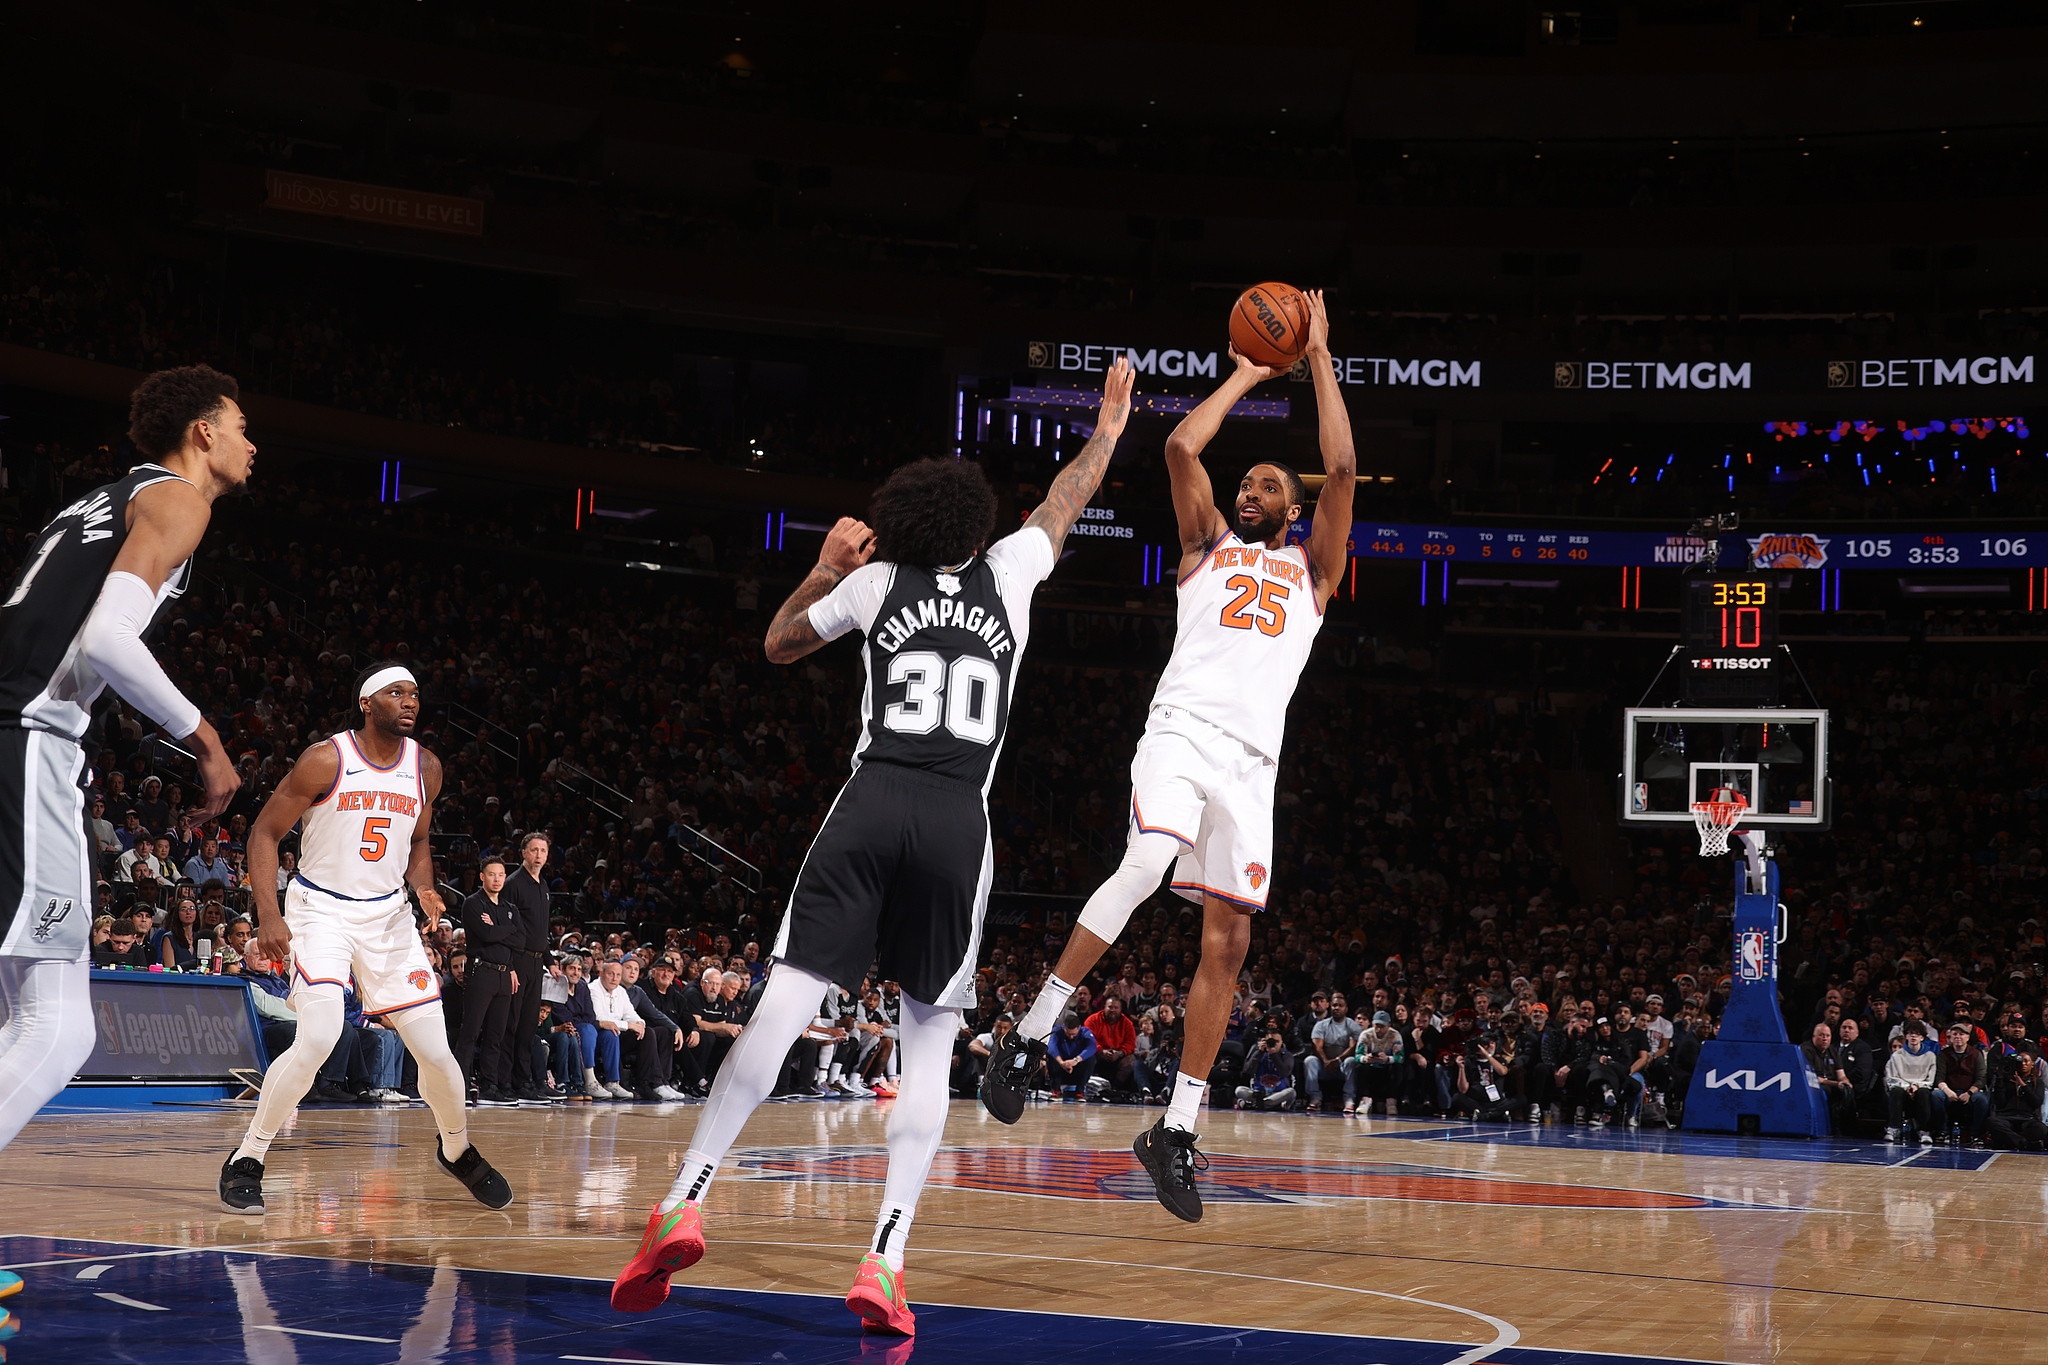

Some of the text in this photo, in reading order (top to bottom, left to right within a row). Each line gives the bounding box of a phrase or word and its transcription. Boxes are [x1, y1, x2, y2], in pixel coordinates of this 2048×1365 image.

[273, 177, 476, 227] Infosys SUITE LEVEL
[1248, 291, 1286, 342] Wilson
[1587, 361, 1751, 389] BETMGM
[1860, 355, 2034, 388] BETMGM
[1069, 523, 1134, 539] ARRIORS
[1377, 528, 1399, 537] FG%
[1427, 530, 1449, 540] FT%
[1479, 533, 1493, 541] TO
[1507, 534, 1526, 543] STL
[1538, 535, 1557, 544] AST
[1569, 535, 1589, 544] REB
[1666, 536, 1683, 546] NEW
[1922, 535, 1944, 545] 4th
[1371, 540, 1405, 554] 44.4
[1422, 543, 1456, 557] 92.9
[1481, 546, 1492, 558] 5
[1512, 547, 1522, 559] 6
[1537, 547, 1557, 560] 26
[1568, 548, 1588, 561] 40
[1654, 546, 1707, 563] KNICK
[1755, 534, 1821, 558] KNICKS
[1846, 539, 1892, 558] 105
[1908, 547, 1960, 564] 3:53
[1980, 538, 2028, 557] 106
[2, 528, 68, 607] 1
[1211, 547, 1306, 592] NEW YORK
[1220, 574, 1300, 638] 25
[1713, 582, 1766, 606] 3:53
[876, 598, 1012, 661] CHAMPAGNIE
[1721, 607, 1761, 648] 10
[1712, 658, 1772, 670] TISSOT
[883, 650, 1001, 747] 30
[336, 790, 418, 818] NEW YORK
[359, 816, 392, 863] 5
[113, 1002, 240, 1065] League Pass
[1705, 1068, 1792, 1093] KIA
